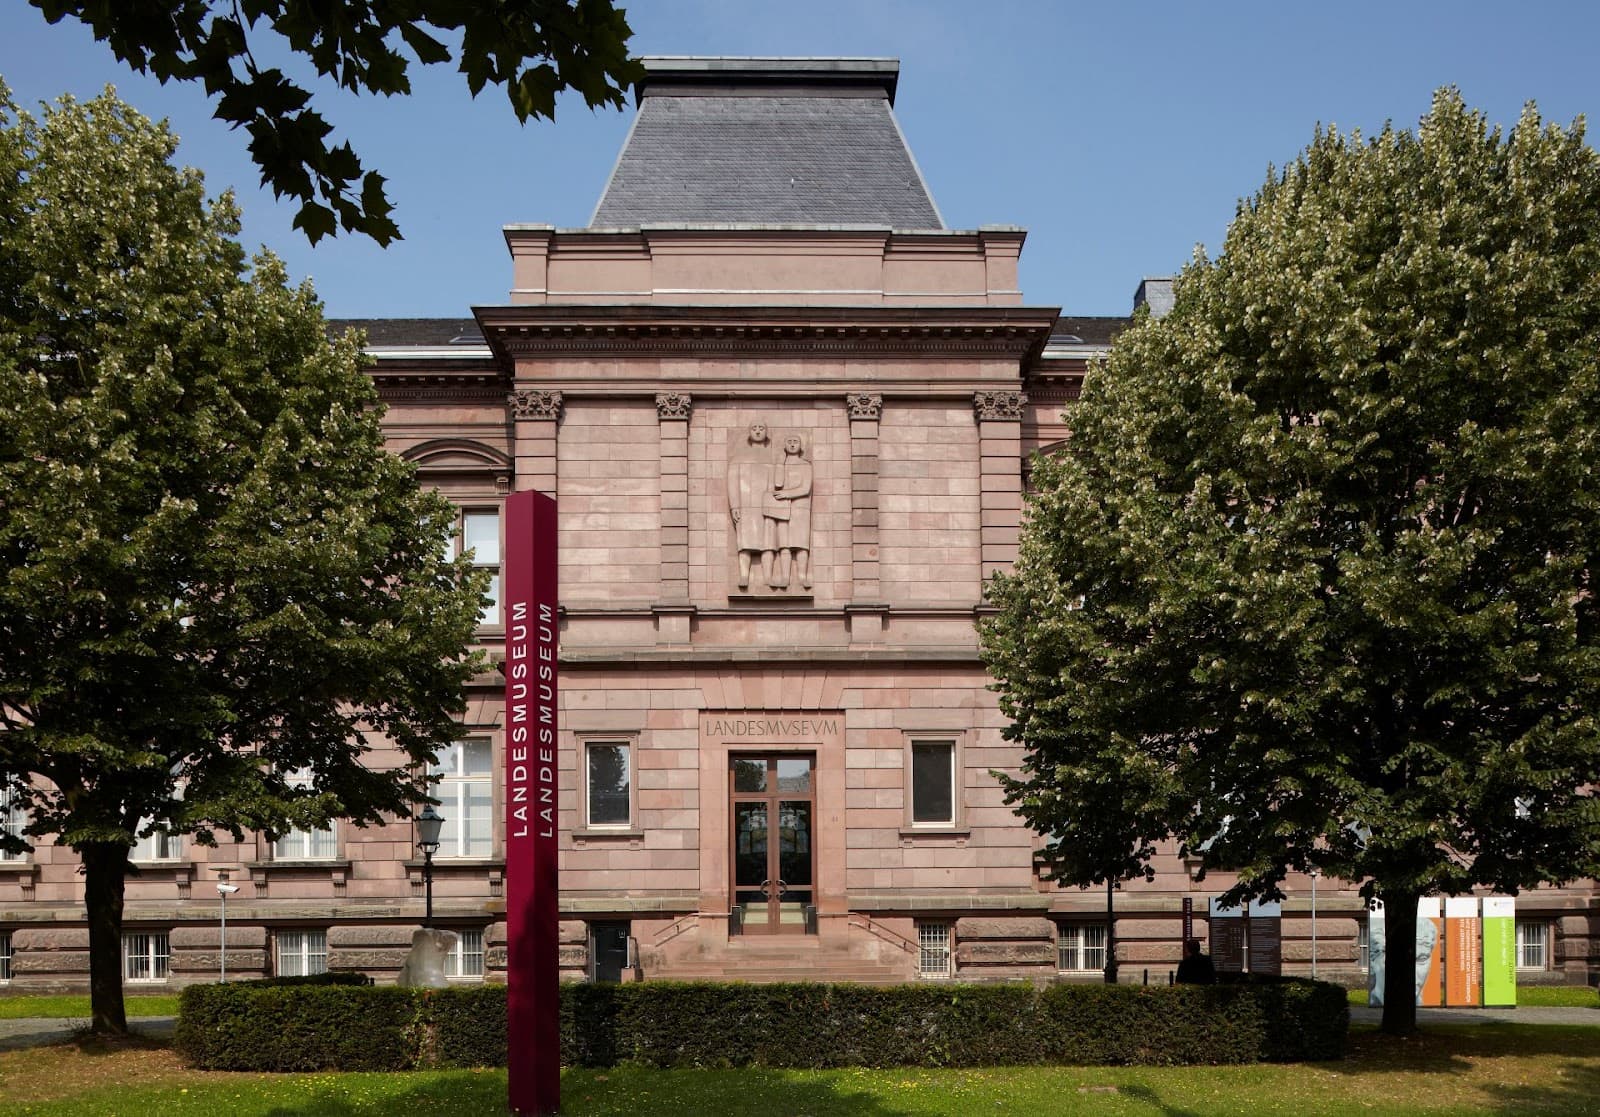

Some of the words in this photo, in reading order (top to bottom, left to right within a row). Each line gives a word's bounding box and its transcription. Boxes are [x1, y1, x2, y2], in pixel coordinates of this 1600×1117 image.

[512, 601, 527, 837] LANDESMUSEUM
[539, 603, 553, 838] LANDESMUSEUM
[706, 720, 838, 736] LANDESMVSEVM
